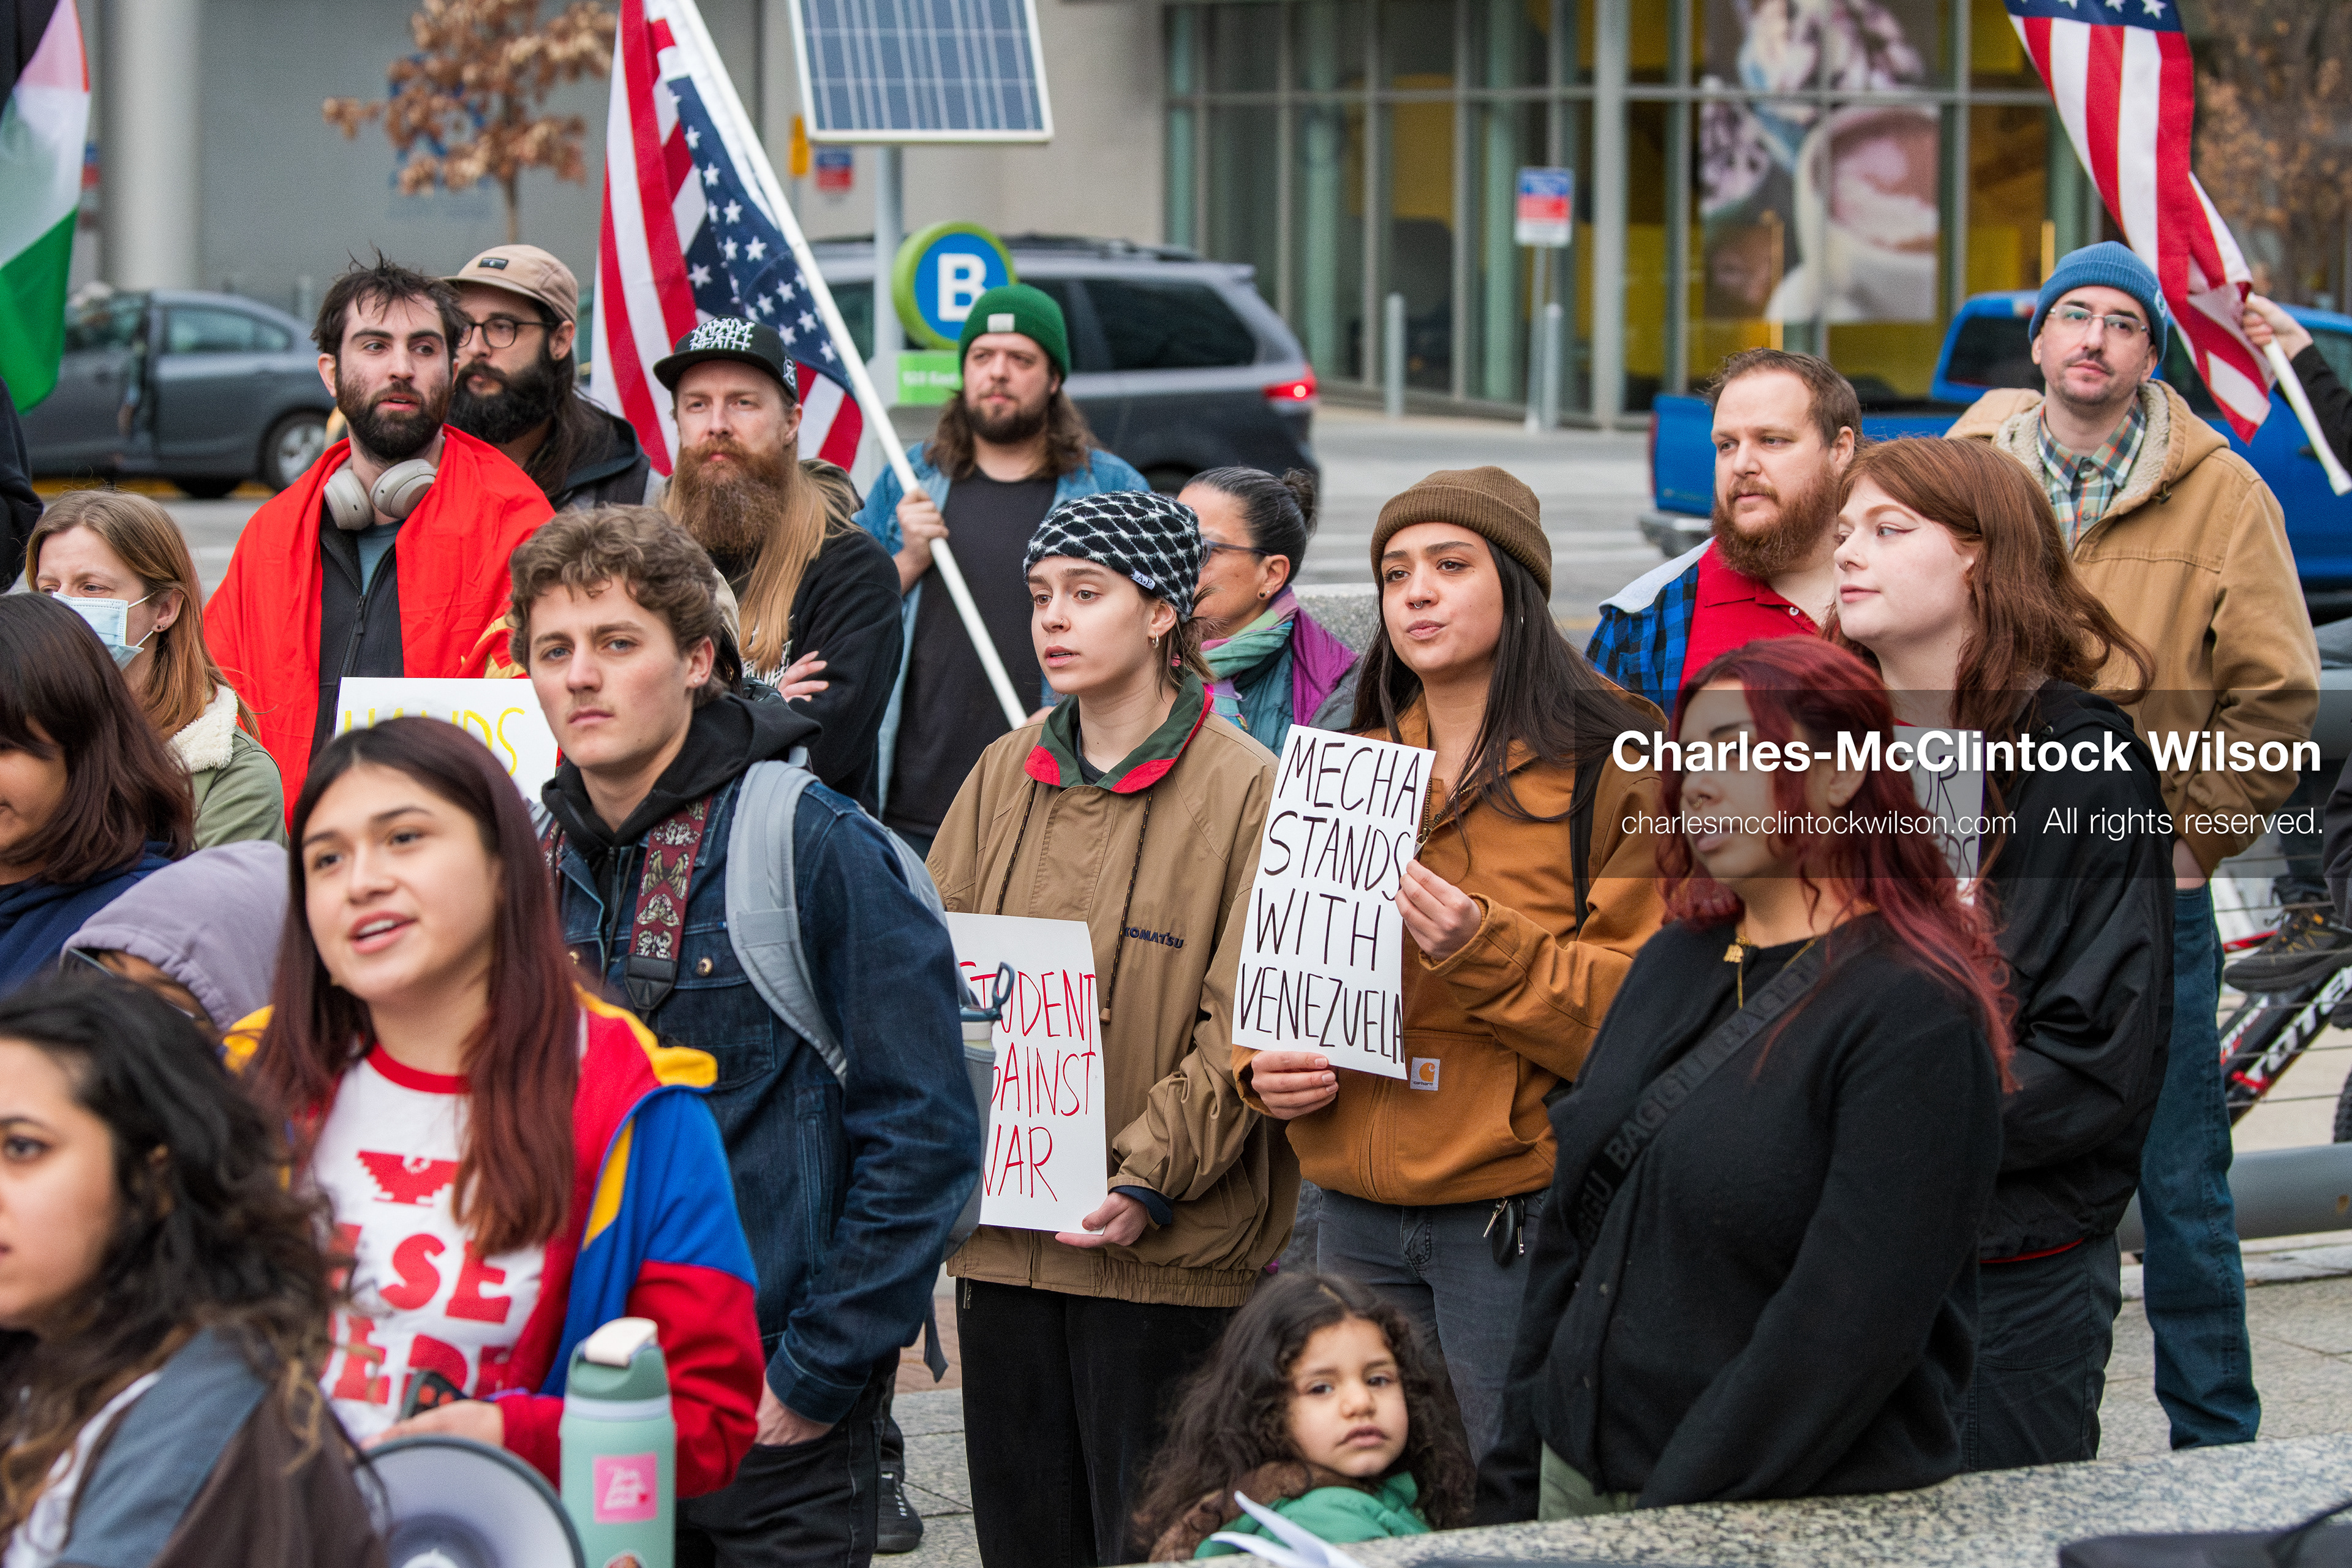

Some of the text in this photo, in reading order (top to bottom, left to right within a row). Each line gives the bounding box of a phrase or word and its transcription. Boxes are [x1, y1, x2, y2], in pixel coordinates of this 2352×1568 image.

[938, 253, 987, 322] B
[1279, 735, 1420, 825] MECHA
[1264, 810, 1411, 901] STANDS
[1256, 888, 1381, 971] WITH
[1240, 963, 1404, 1064] VENEZUELA
